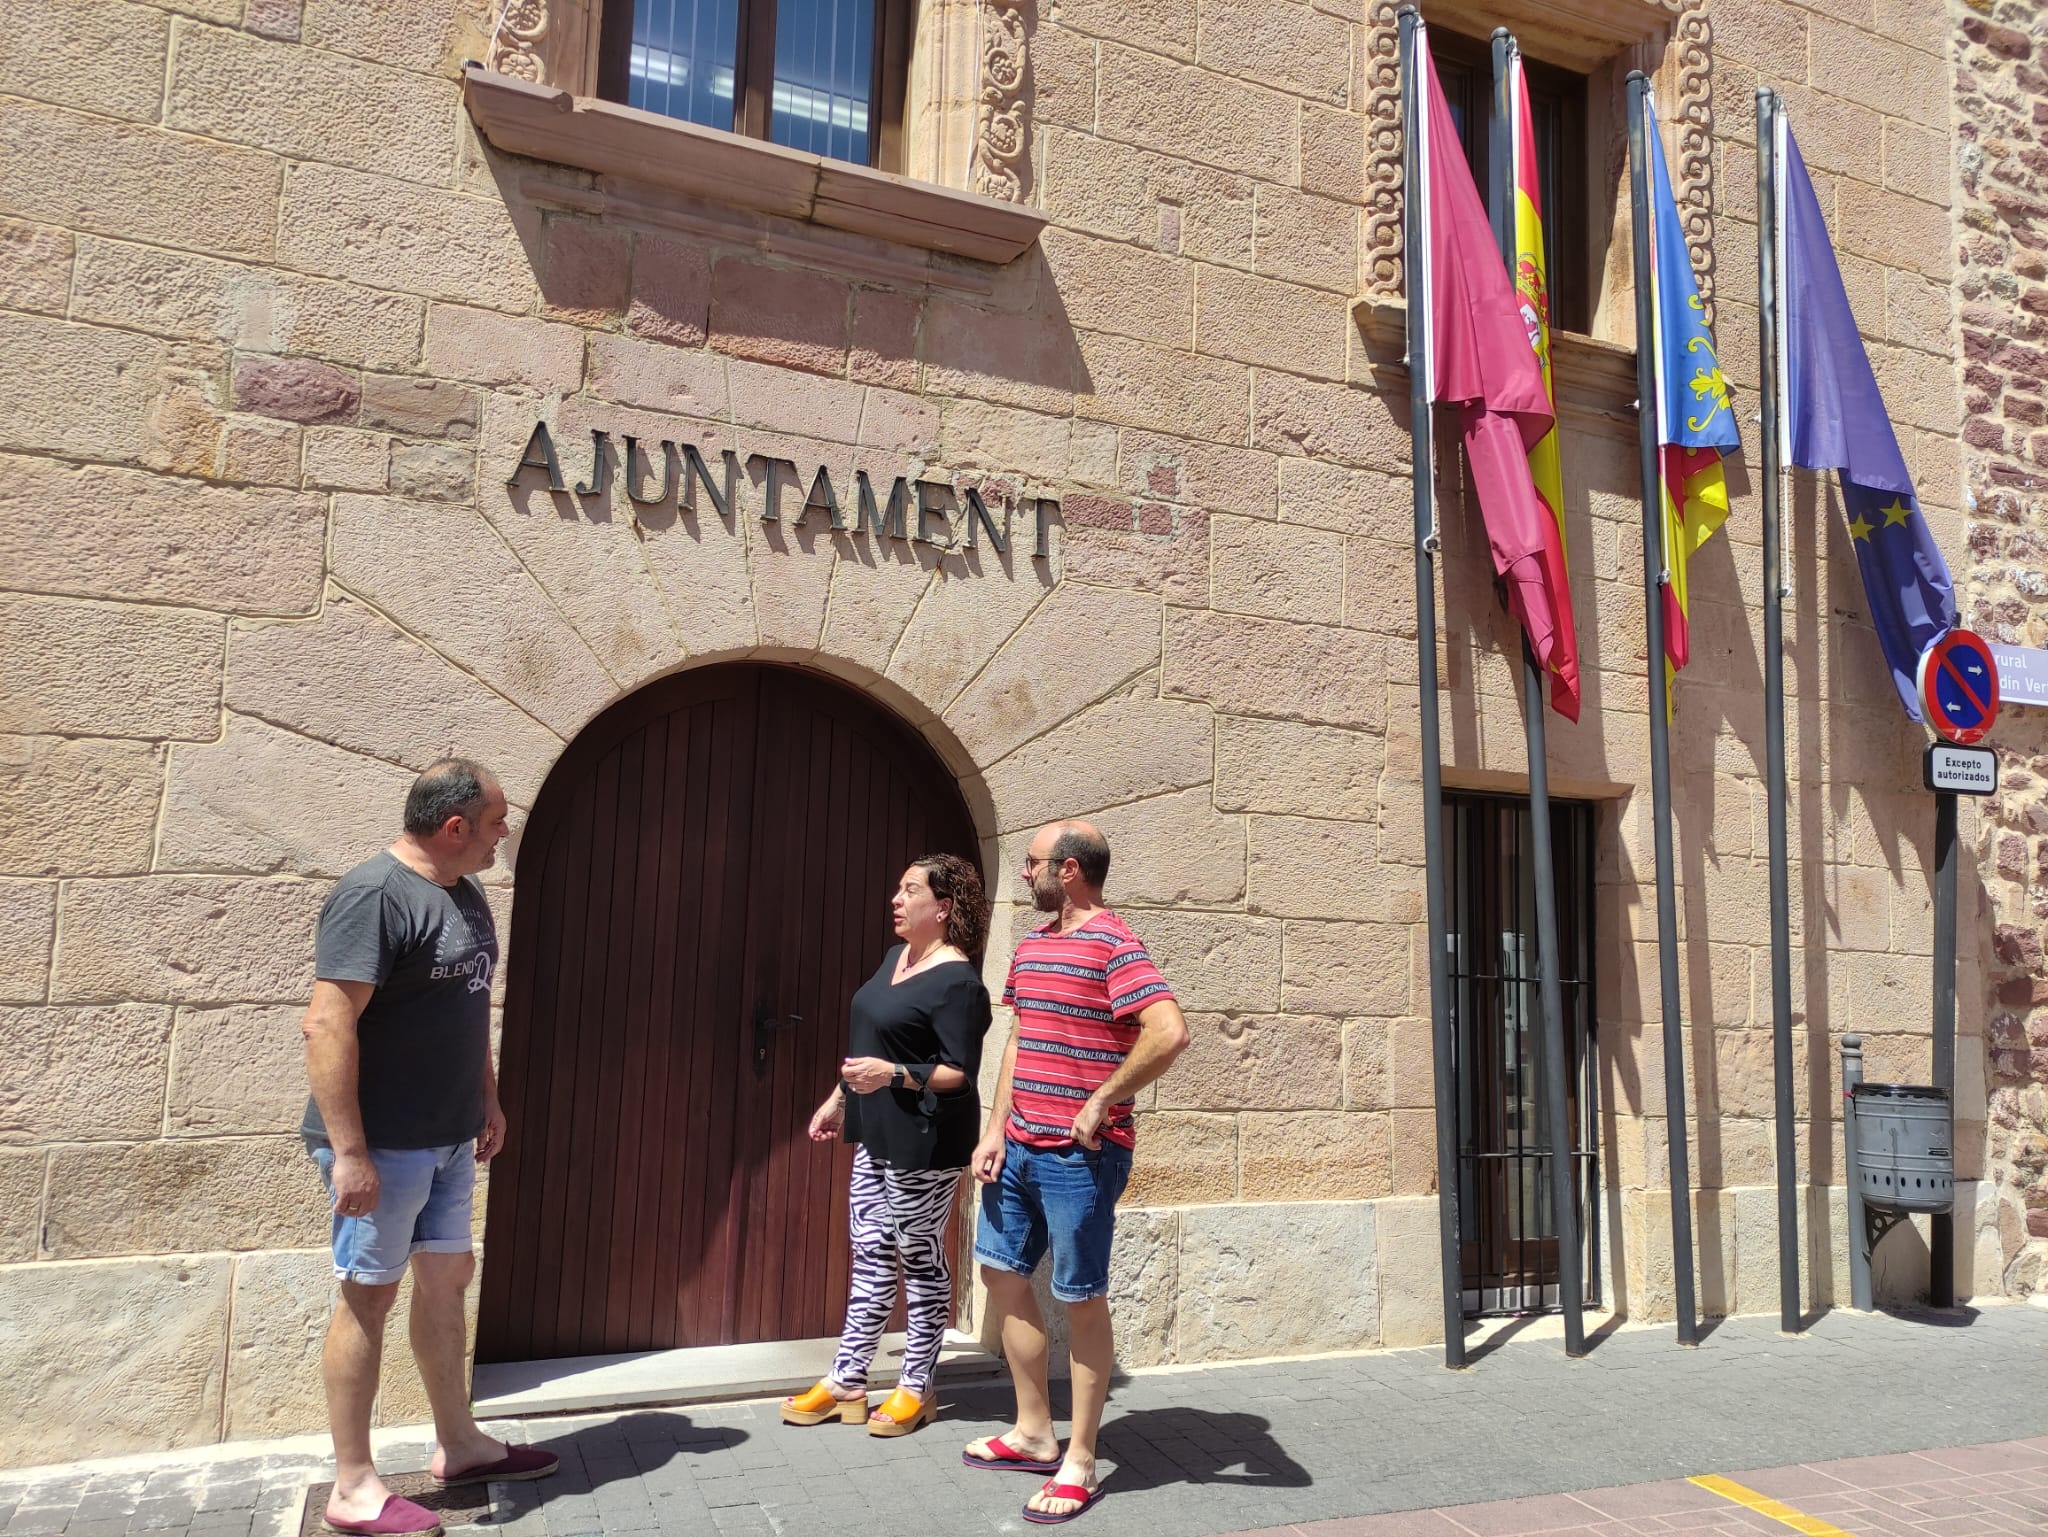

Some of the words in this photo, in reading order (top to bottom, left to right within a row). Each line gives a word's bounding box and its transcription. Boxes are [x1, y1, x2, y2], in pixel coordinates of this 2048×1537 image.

[506, 420, 1061, 559] AJUNTAMENT
[1995, 654, 2028, 669] rural
[2025, 677, 2048, 694] Ver
[1946, 757, 1981, 769] Excepto
[1938, 770, 1990, 782] autorizados
[430, 960, 474, 979] BLEND
